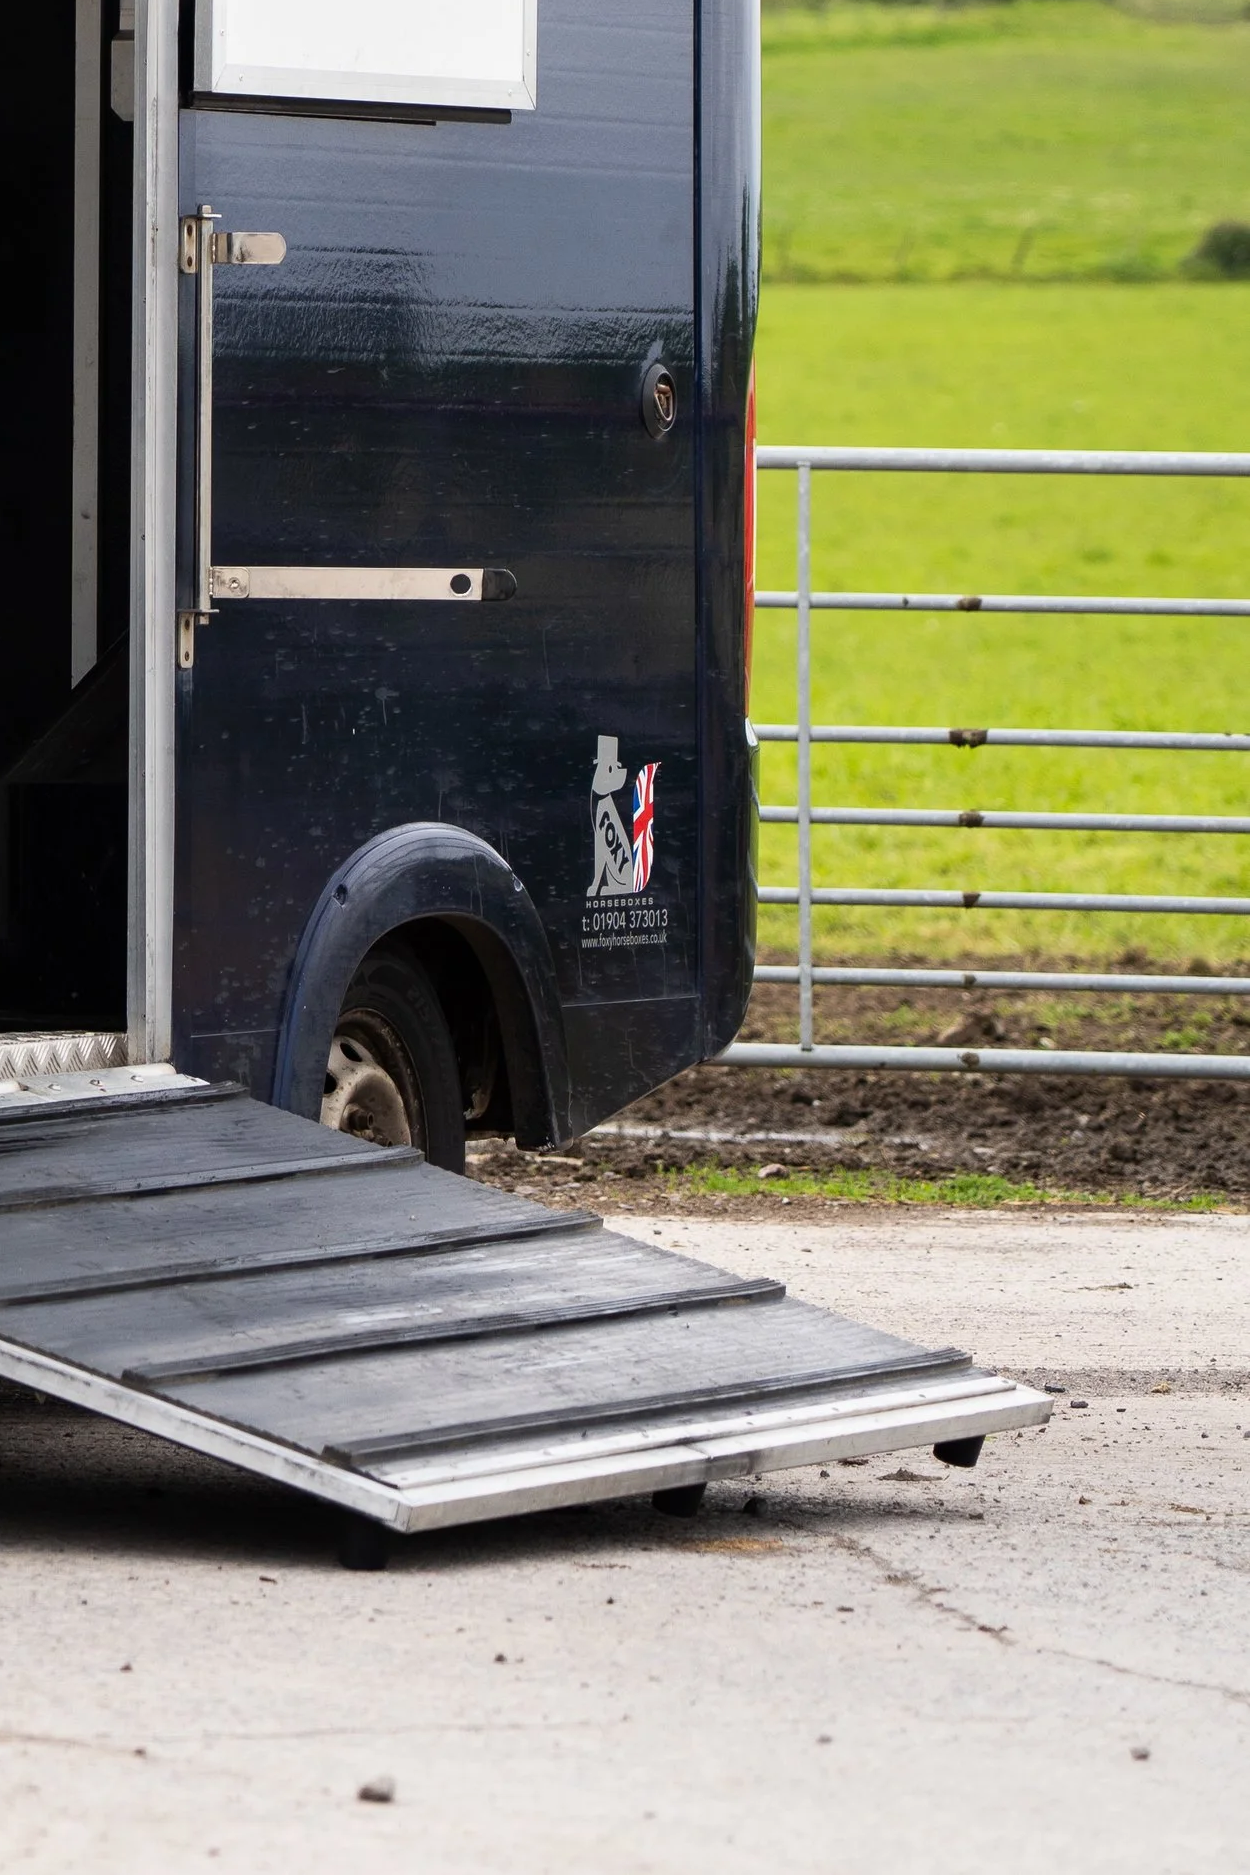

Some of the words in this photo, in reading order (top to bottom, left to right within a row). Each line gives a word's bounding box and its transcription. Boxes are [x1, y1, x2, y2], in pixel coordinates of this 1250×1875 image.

[599, 811, 630, 875] FOXY
[586, 897, 654, 909] HORSEBOXES
[582, 916, 590, 931] t:
[593, 912, 626, 931] 01904
[629, 909, 668, 928] 373013
[581, 930, 667, 950] www.foxyhorseboxes.co.uk
